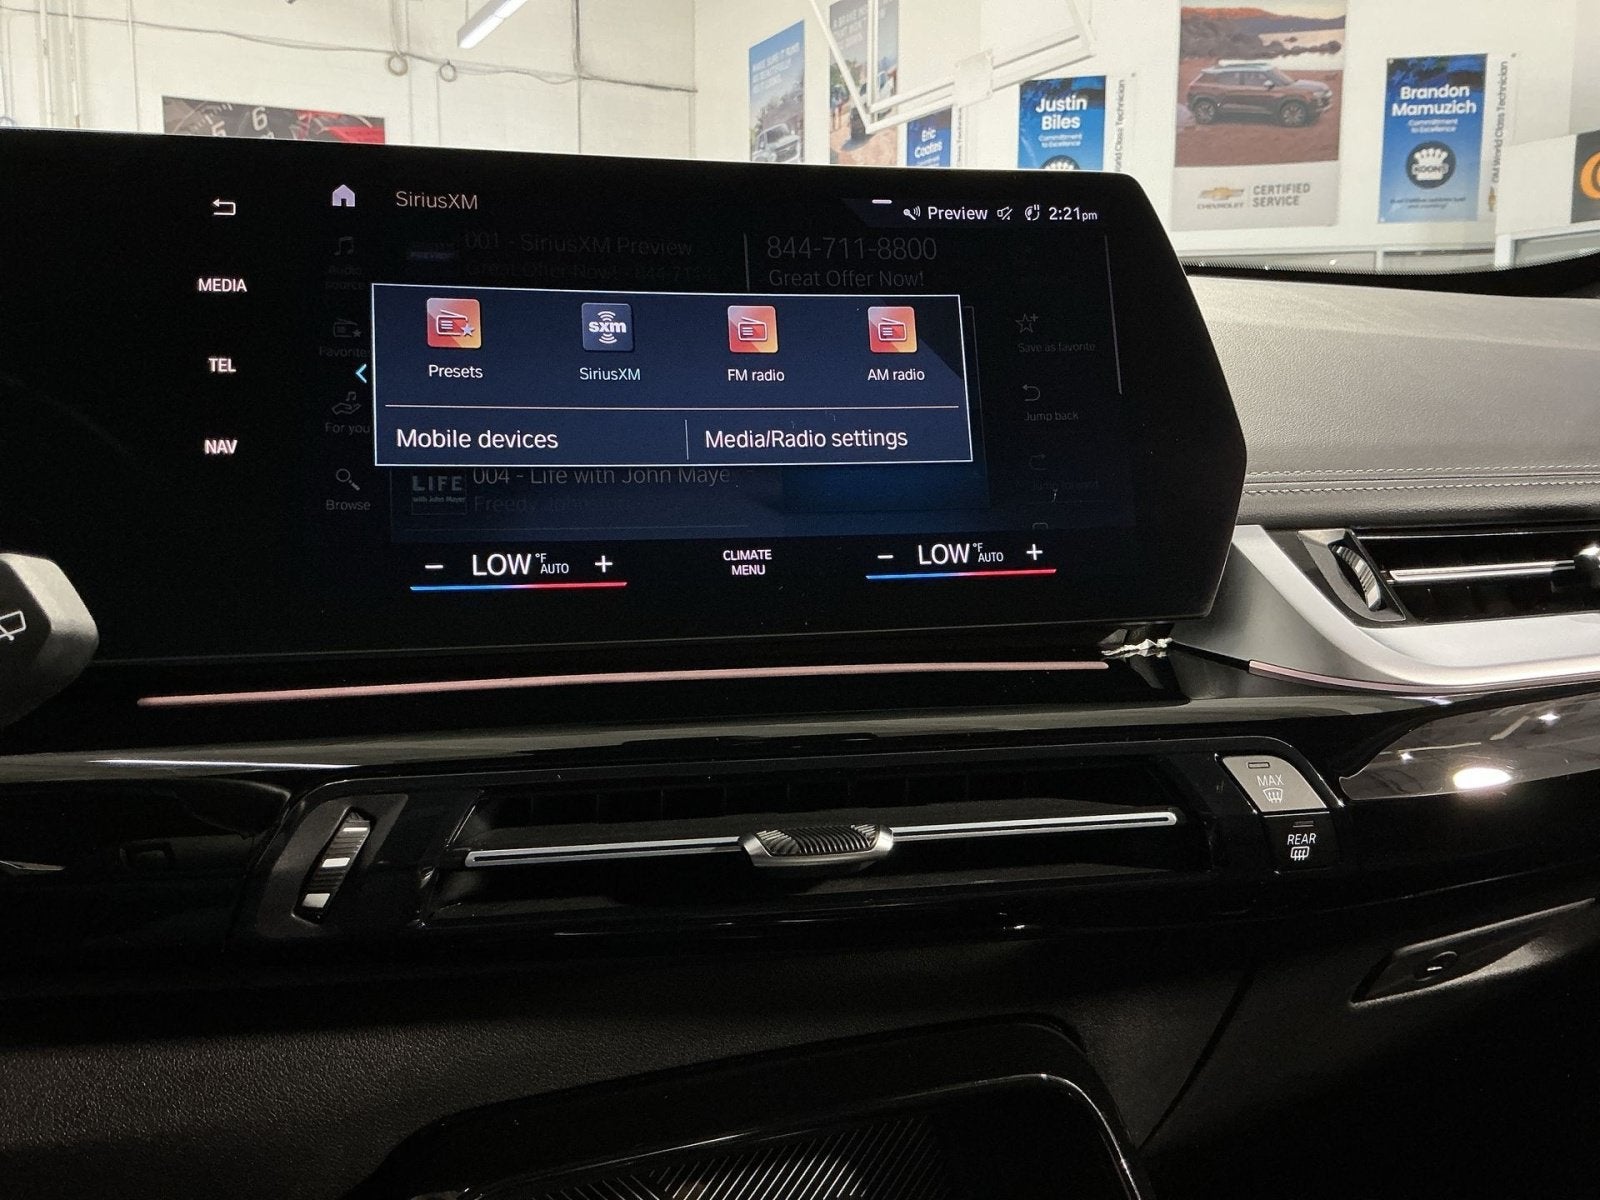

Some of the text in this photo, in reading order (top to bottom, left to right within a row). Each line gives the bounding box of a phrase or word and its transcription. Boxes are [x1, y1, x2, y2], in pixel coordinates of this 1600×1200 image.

[1400, 84, 1470, 100] Brandon
[1035, 94, 1088, 113] Justin
[1391, 100, 1477, 117] Mamuzich
[1041, 114, 1081, 131] Biles
[1494, 113, 1505, 138] Class
[1252, 182, 1311, 196] CERTIFIED
[395, 190, 479, 211] SiriusXM
[1252, 195, 1300, 208] SERVICE
[927, 206, 988, 221] Preview
[1048, 206, 1098, 222] 2:21pm
[767, 236, 937, 261] 844-711-8800
[197, 278, 248, 293] MEDIA
[768, 269, 925, 287] Great Offer Now!
[588, 320, 627, 334] sxm
[208, 356, 236, 374] TEL
[428, 363, 484, 380] Presets
[579, 366, 641, 382] SiriusXM
[727, 368, 785, 382] FM radio
[867, 368, 925, 382] AM radio
[1024, 411, 1079, 422] Jump back
[325, 422, 371, 434] For you
[204, 438, 239, 455] NAV
[396, 429, 559, 449] Mobile devices
[705, 430, 909, 450] Media/Radio settings
[411, 475, 463, 492] LIFE
[573, 468, 615, 484] with
[622, 468, 672, 484] John
[325, 499, 372, 511] Browse
[722, 549, 773, 562] CLIMATE
[917, 543, 970, 565] LOW
[977, 552, 1004, 562] AUTO
[472, 553, 532, 576] LOW
[540, 563, 570, 574] AUTO
[731, 564, 766, 577] MENU
[1256, 774, 1285, 787] MAX
[1287, 832, 1317, 846] REAR
